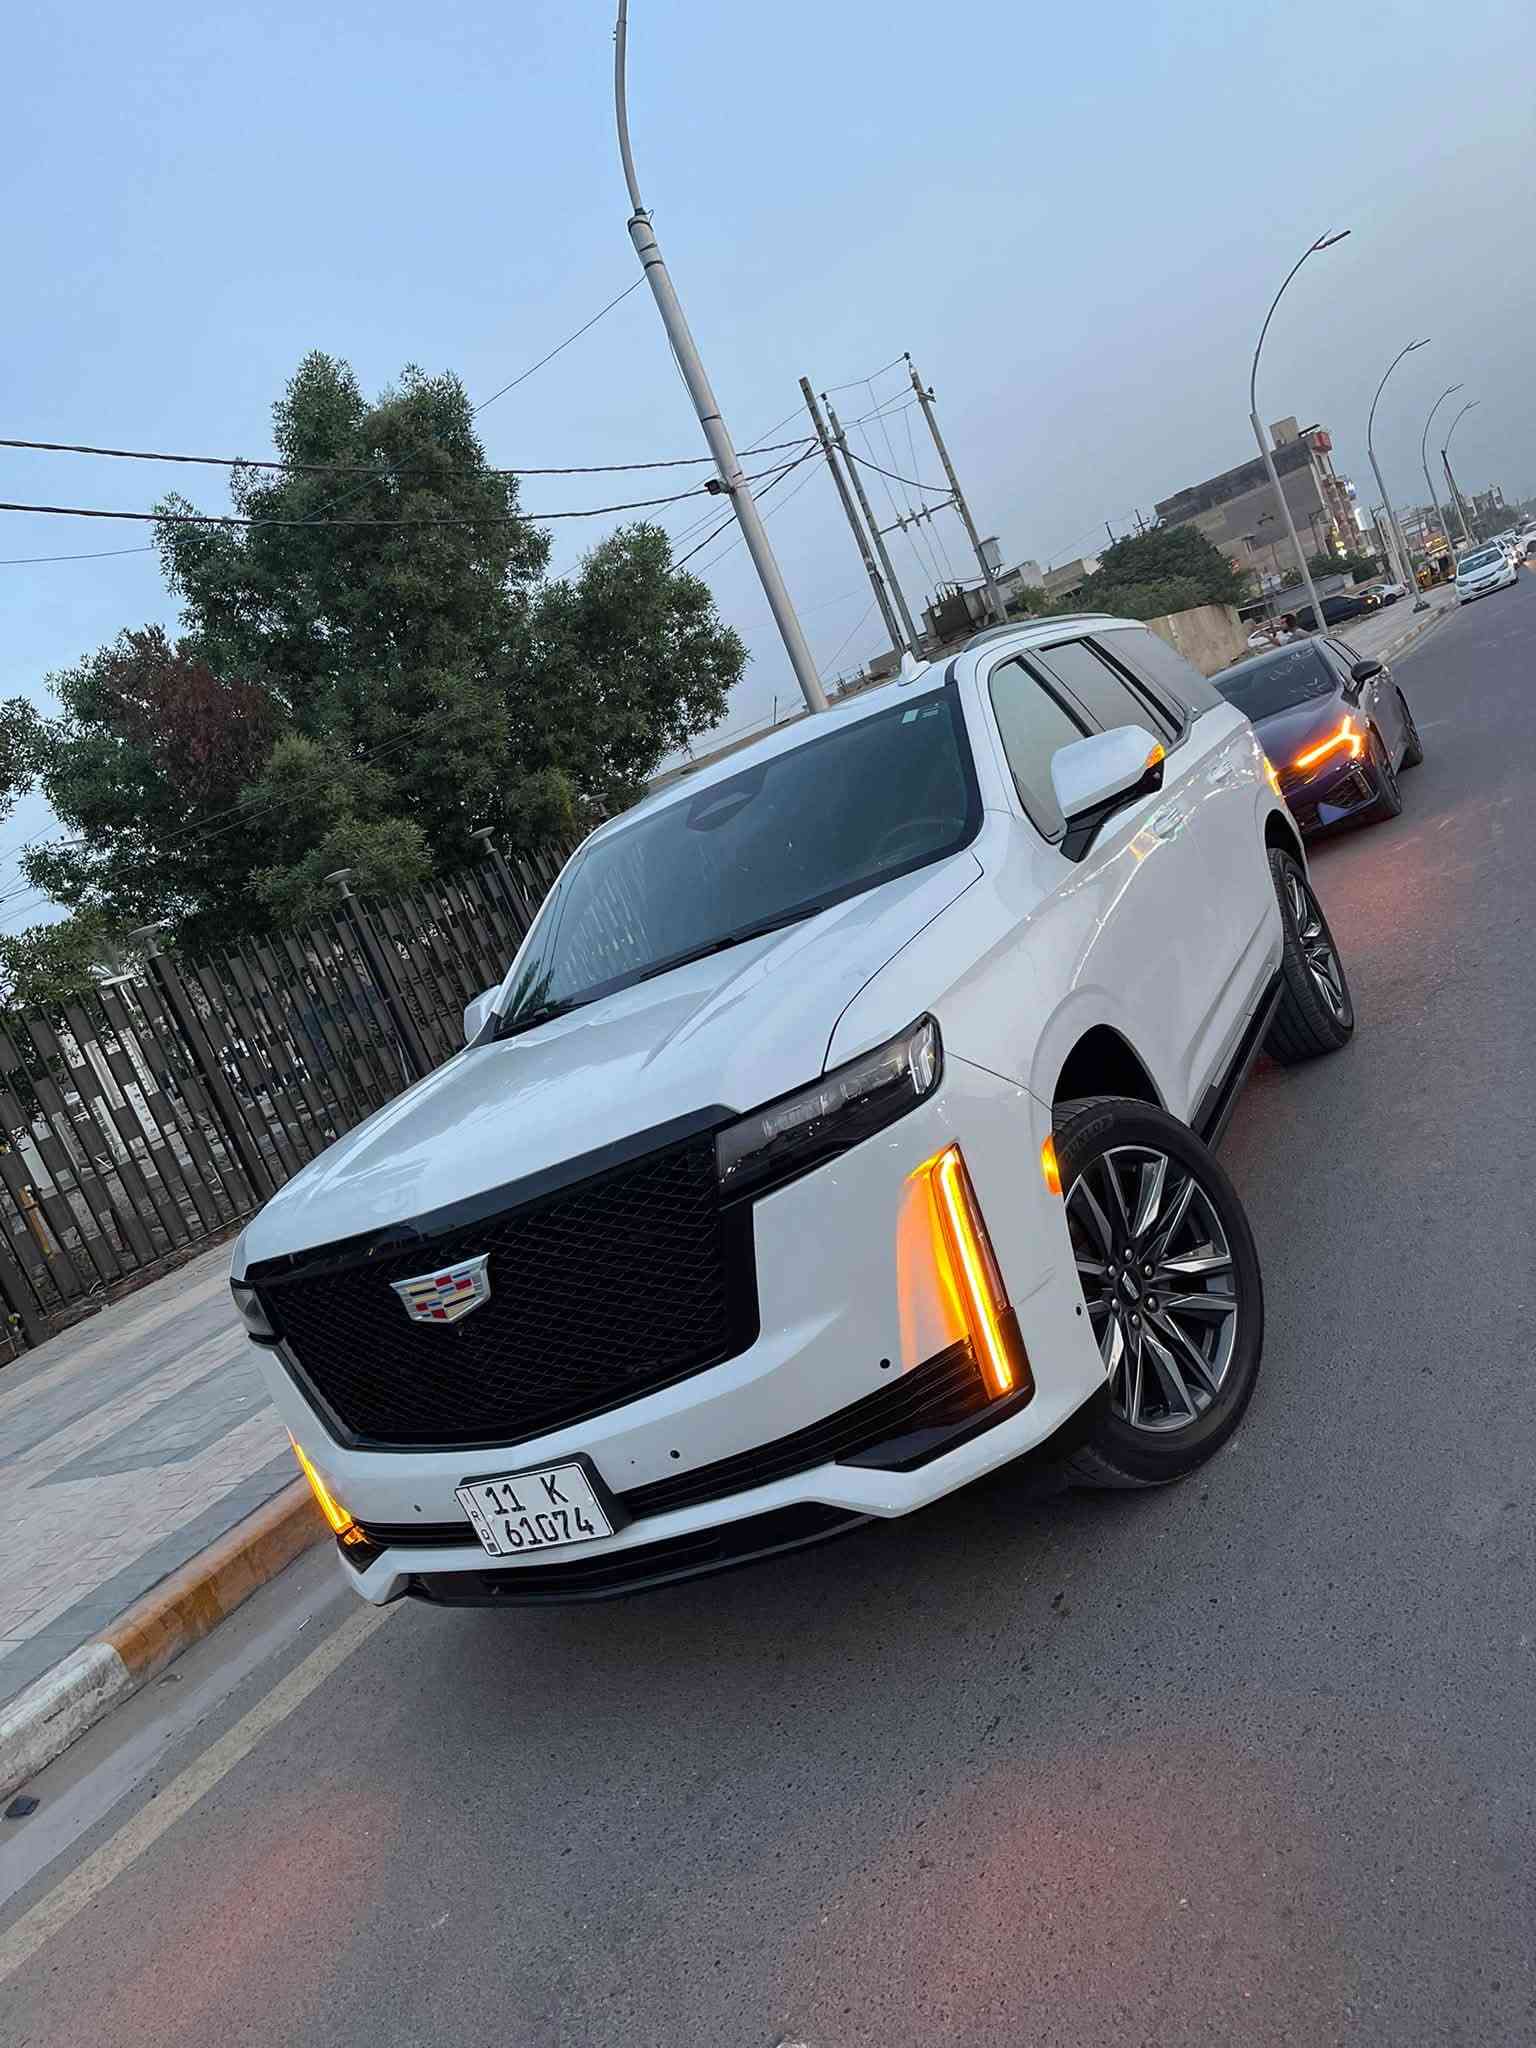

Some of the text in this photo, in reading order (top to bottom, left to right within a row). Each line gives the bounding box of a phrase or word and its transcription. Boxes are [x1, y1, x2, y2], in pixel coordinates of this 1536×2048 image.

[485, 1474, 569, 1515] 11 K
[504, 1506, 595, 1547] 61074
